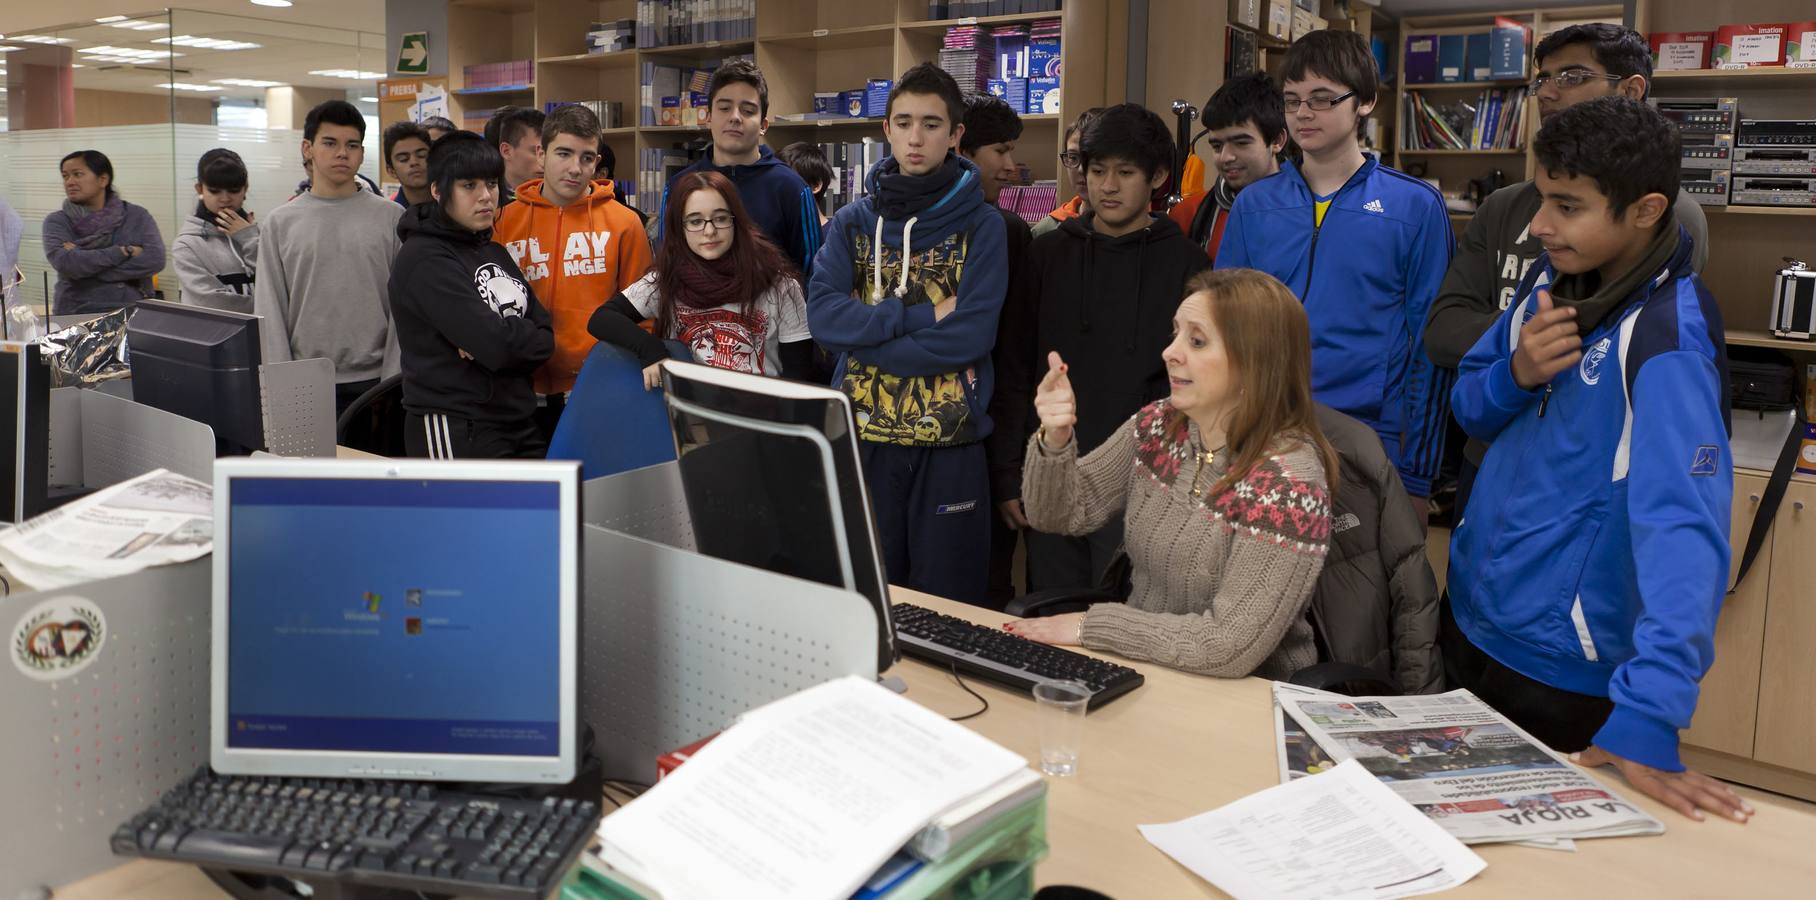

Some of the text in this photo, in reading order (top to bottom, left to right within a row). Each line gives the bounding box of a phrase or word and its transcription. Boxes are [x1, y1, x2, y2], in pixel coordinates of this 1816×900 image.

[1758, 26, 1783, 34] imation
[390, 84, 416, 96] PRENSA
[1363, 204, 1384, 213] adidas
[946, 502, 975, 512] MERCURY
[1440, 785, 1532, 799] responsabilidades
[1591, 802, 1639, 815] LA
[1498, 804, 1593, 826] RIOJA
